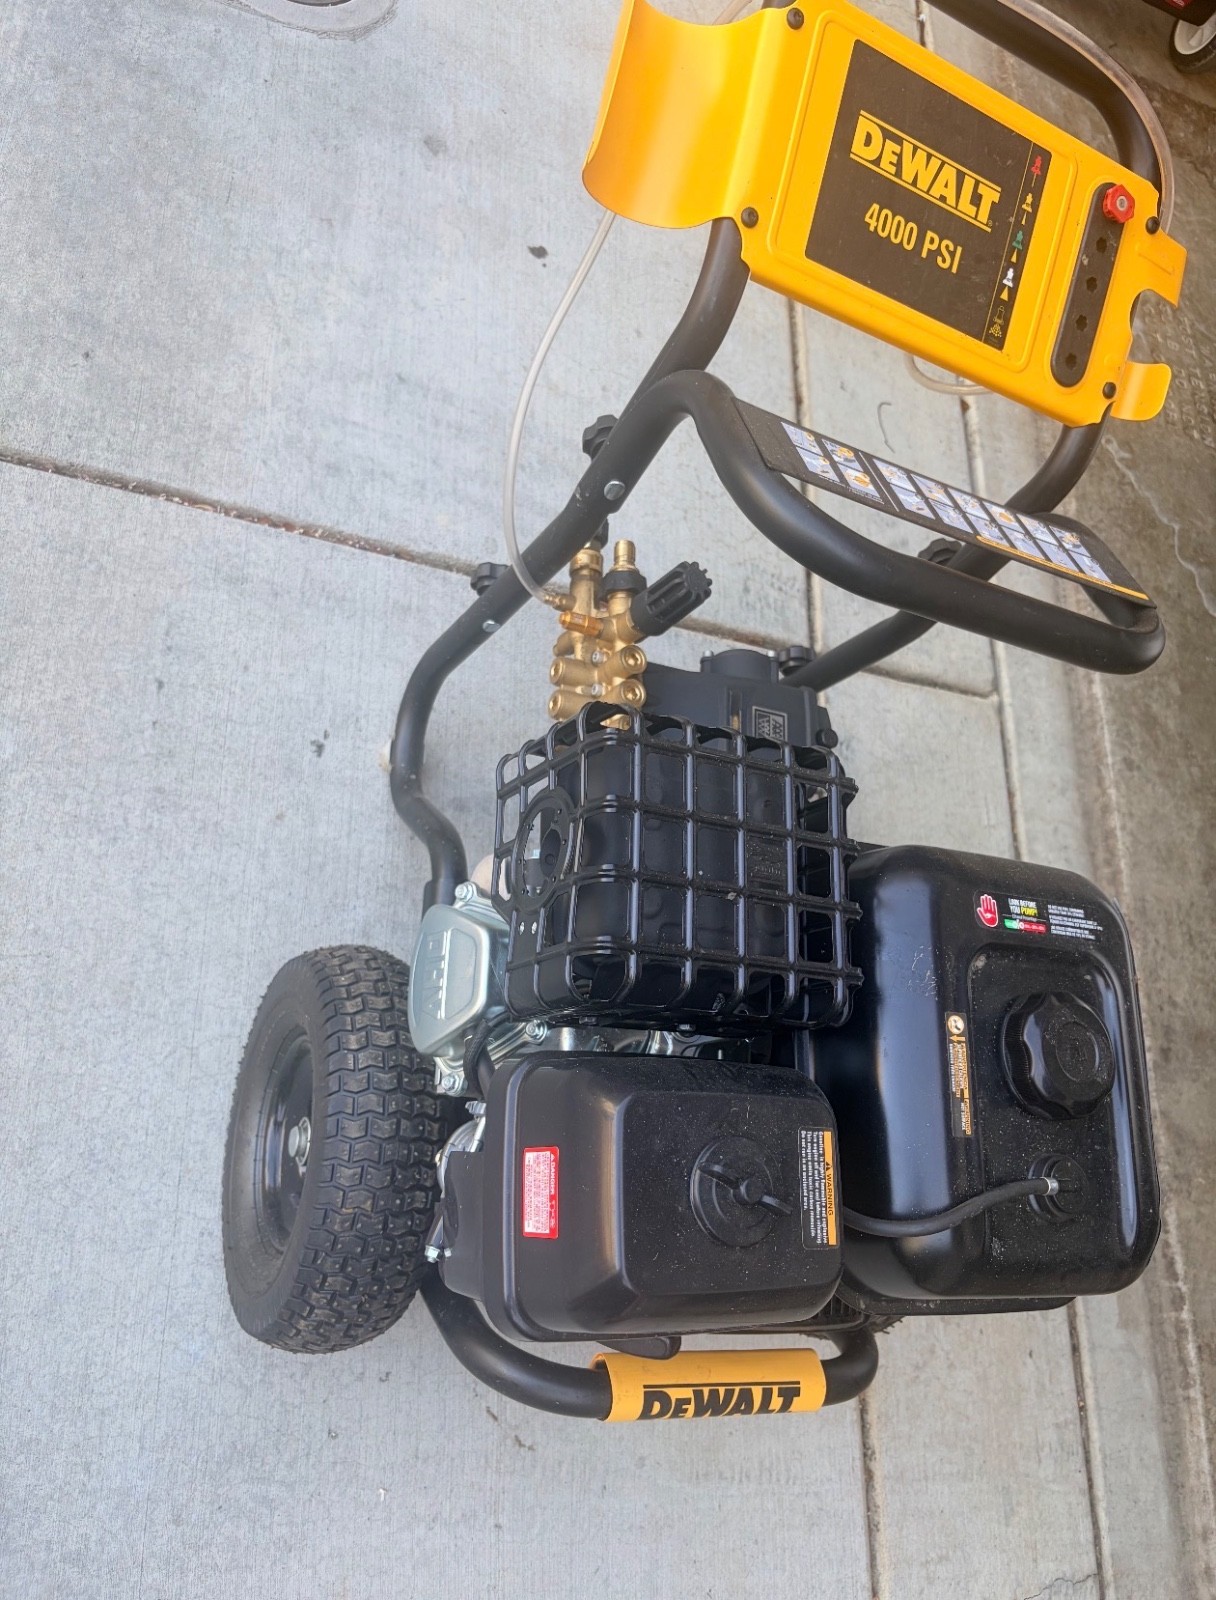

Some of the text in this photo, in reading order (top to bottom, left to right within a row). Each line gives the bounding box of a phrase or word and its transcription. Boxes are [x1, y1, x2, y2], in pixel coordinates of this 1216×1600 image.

[864, 203, 963, 274] 4000 PSI
[826, 1173, 834, 1216] WARNING
